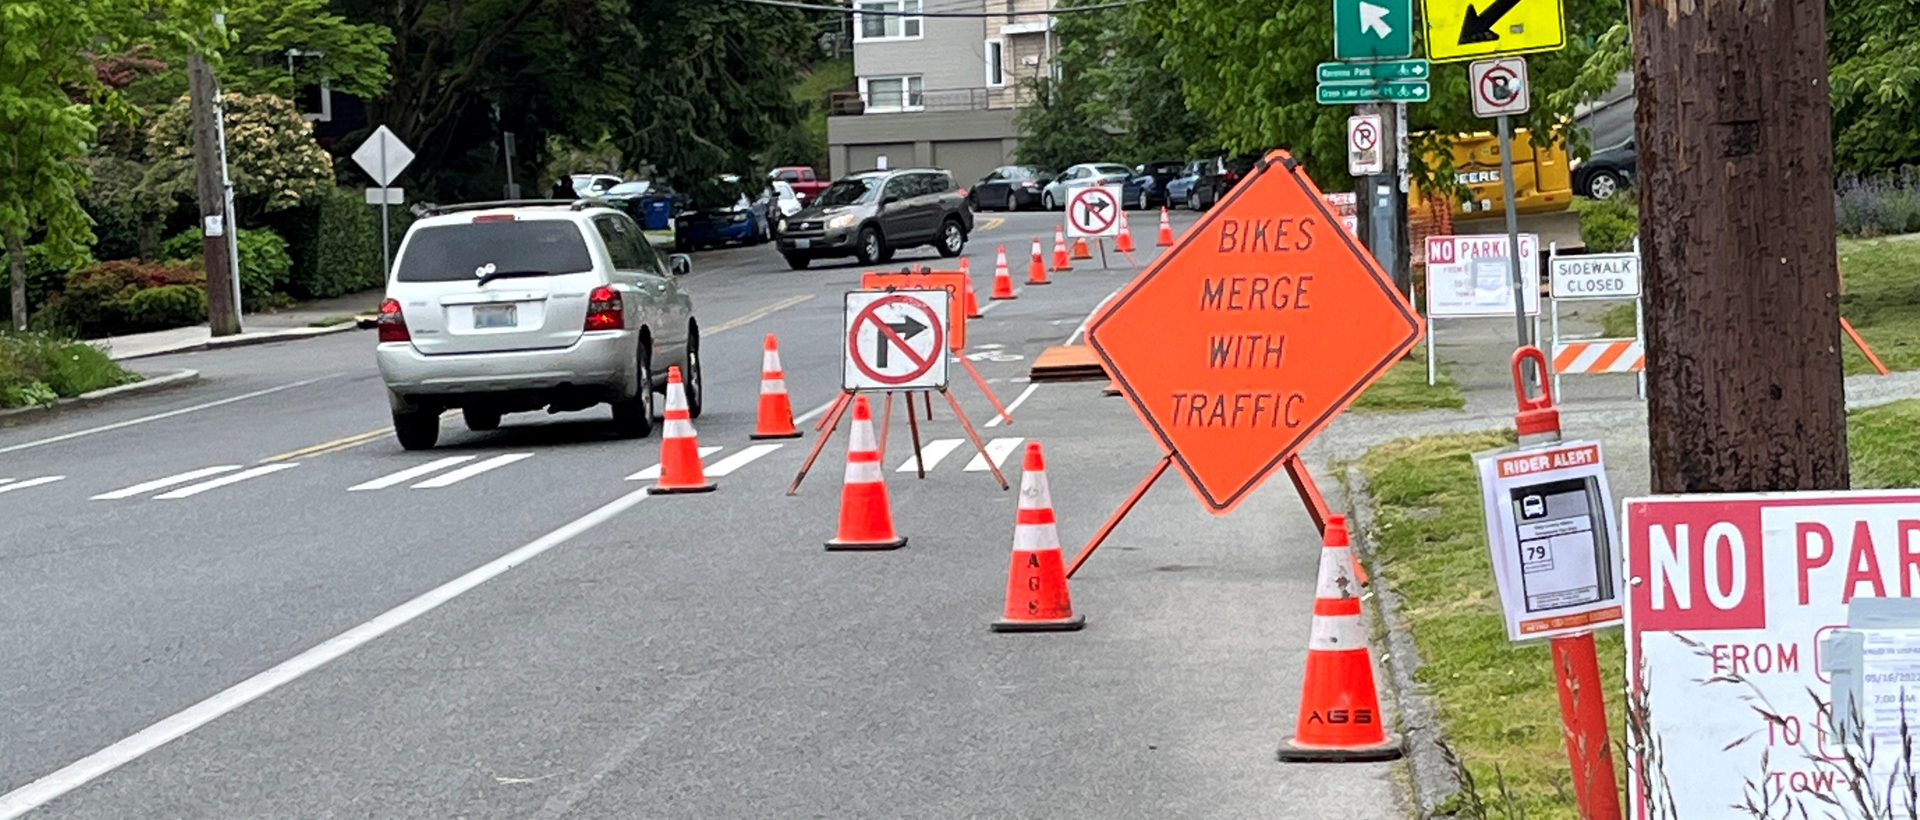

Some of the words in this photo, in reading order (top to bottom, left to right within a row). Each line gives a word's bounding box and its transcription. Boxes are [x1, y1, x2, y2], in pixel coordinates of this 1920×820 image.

[1354, 67, 1371, 76] Park
[1219, 217, 1316, 253] BIKES
[1431, 241, 1453, 261] NO
[1461, 240, 1529, 260] PARKIG
[1559, 261, 1631, 276] SIDEWALK
[1201, 275, 1313, 311] MERGE
[1567, 278, 1624, 292] CLOSED
[1210, 335, 1285, 369] WITH
[1172, 394, 1305, 428] TRAFFIC
[1503, 455, 1550, 475] RIDER
[1554, 450, 1593, 468] ALERT
[1527, 546, 1546, 560] 79
[1649, 521, 1747, 611] NO
[1712, 643, 1799, 674] FROM
[1308, 709, 1372, 725] AGS
[1766, 716, 1801, 746] TO
